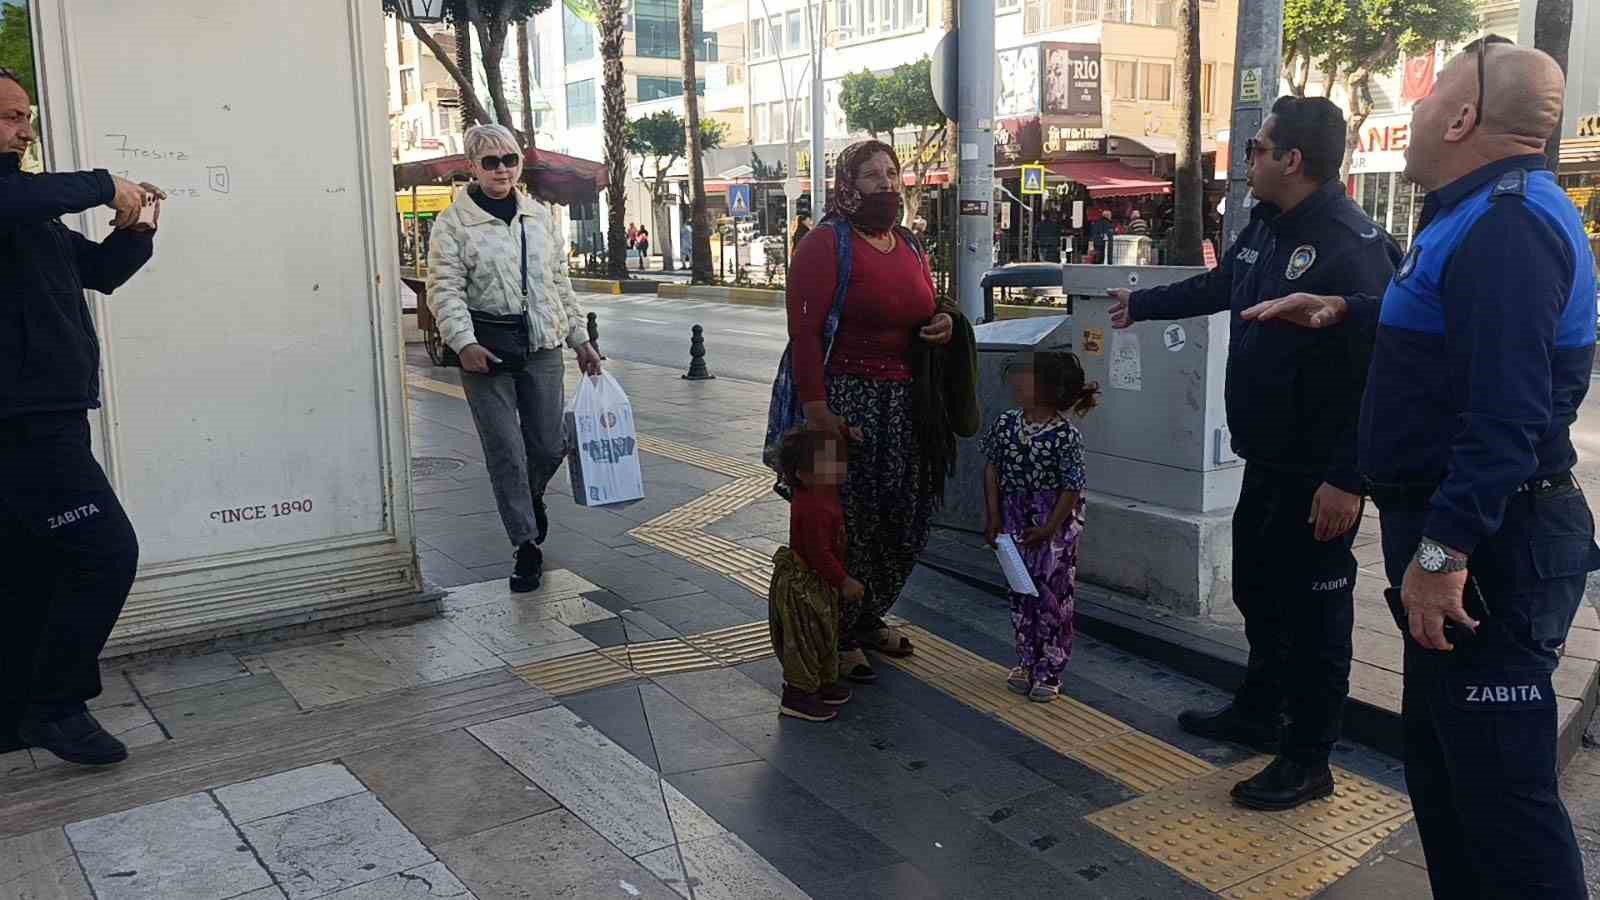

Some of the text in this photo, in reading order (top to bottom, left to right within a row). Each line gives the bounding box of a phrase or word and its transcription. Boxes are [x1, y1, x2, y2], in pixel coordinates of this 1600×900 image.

[47, 503, 100, 529] ZABITA
[271, 499, 313, 517] 1890
[1465, 685, 1542, 702] ZABITA
